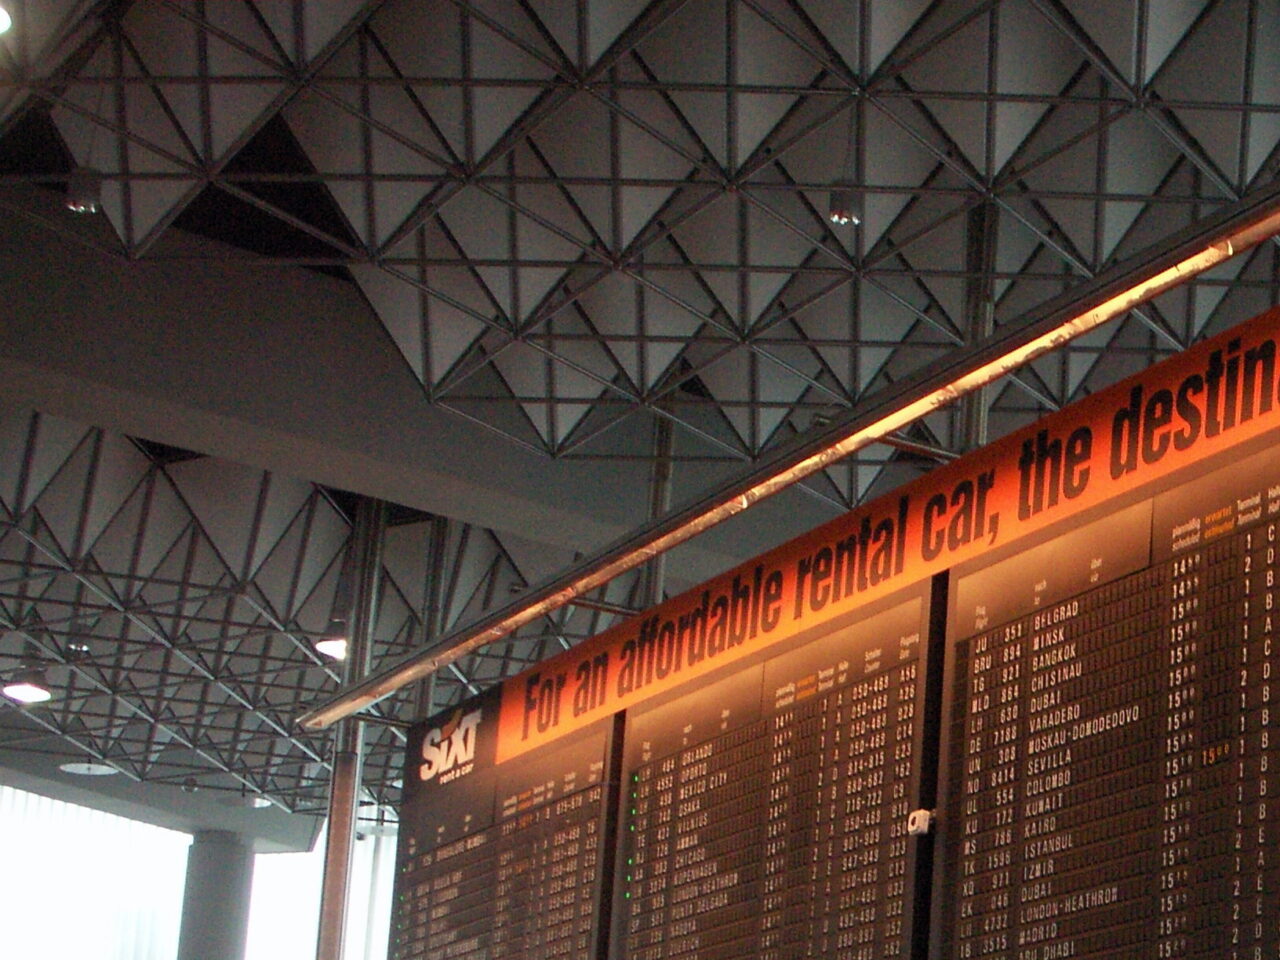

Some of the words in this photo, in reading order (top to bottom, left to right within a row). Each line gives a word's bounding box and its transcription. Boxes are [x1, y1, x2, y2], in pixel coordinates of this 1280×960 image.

[521, 671, 567, 741] For
[573, 652, 609, 717] an
[616, 565, 784, 701] affordable
[794, 497, 908, 620] rental
[920, 465, 999, 565] car,
[1017, 416, 1092, 520] the
[1032, 643, 1077, 671] BANGKOK
[1031, 662, 1082, 692] CHISINAU
[1028, 705, 1140, 754] MOSKAU-DOMODEDOVO
